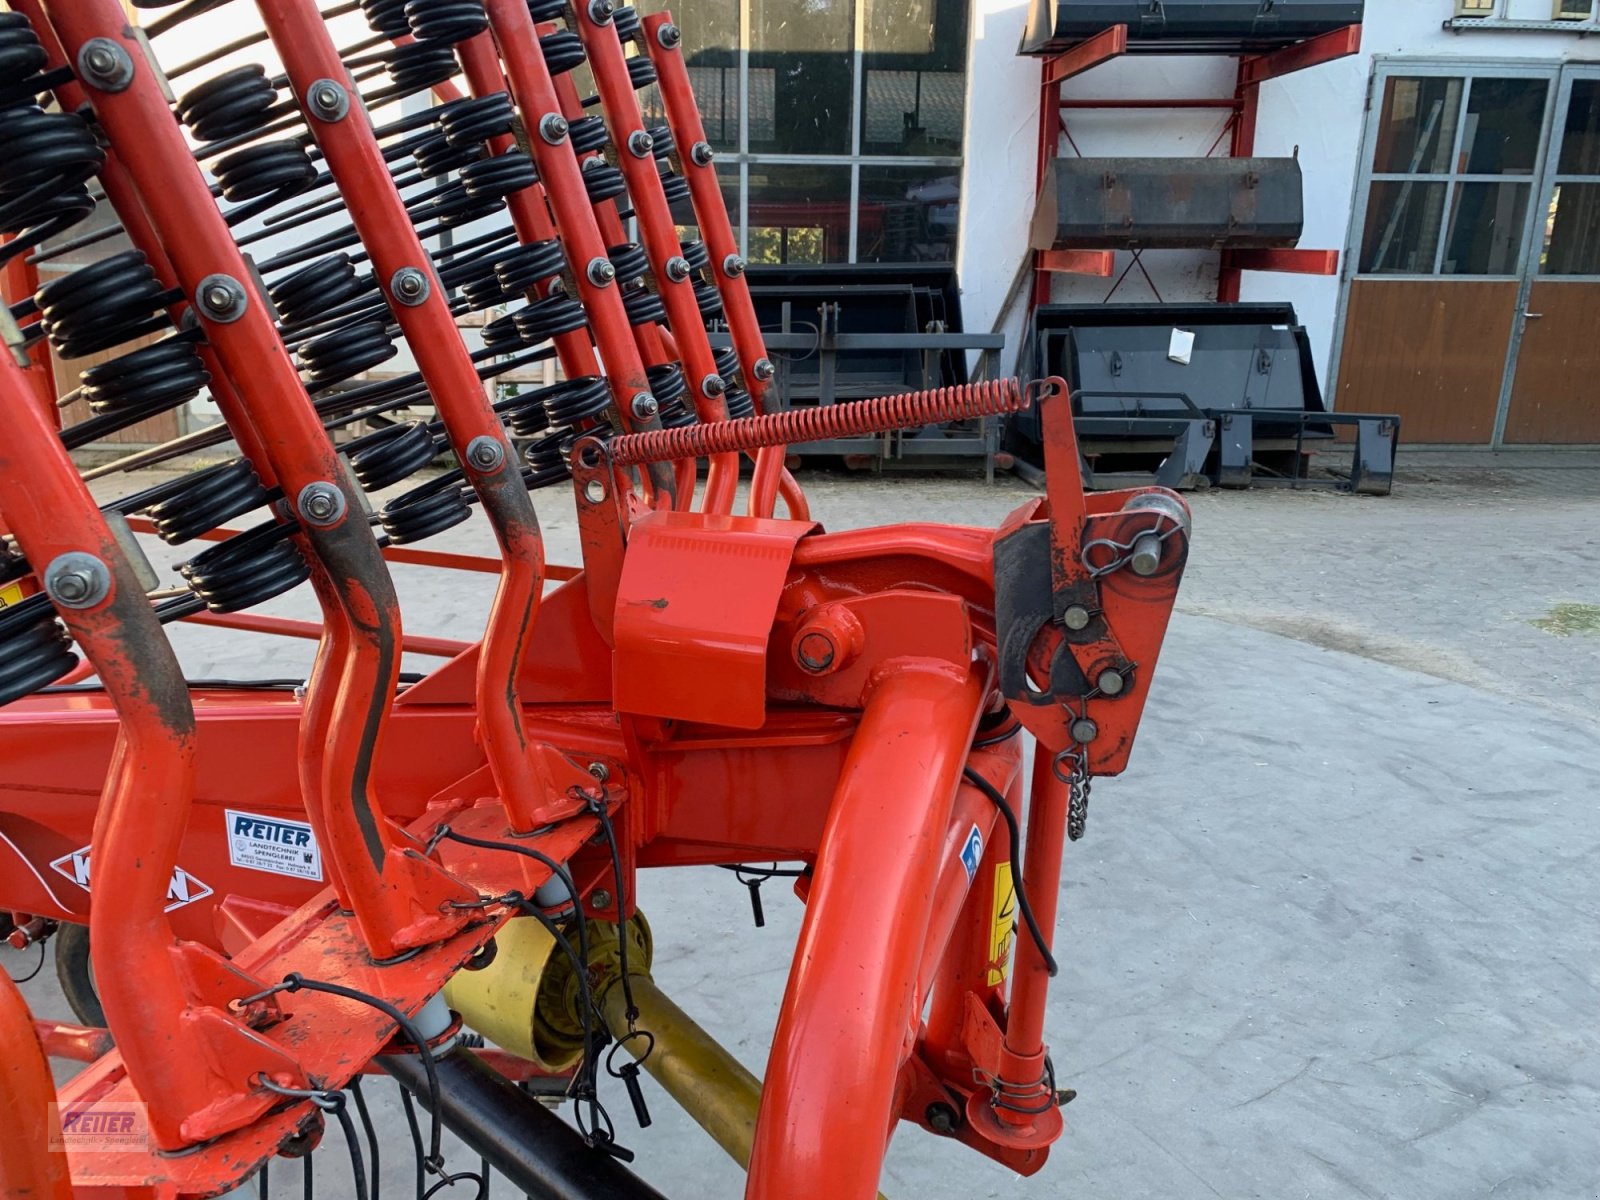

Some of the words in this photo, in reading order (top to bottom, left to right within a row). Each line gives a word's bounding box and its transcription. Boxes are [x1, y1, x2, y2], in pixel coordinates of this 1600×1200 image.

[234, 816, 311, 847] REITER
[250, 842, 298, 855] LANDTECHNIK
[254, 849, 295, 861] SPENGLEREI
[72, 853, 189, 903] KN
